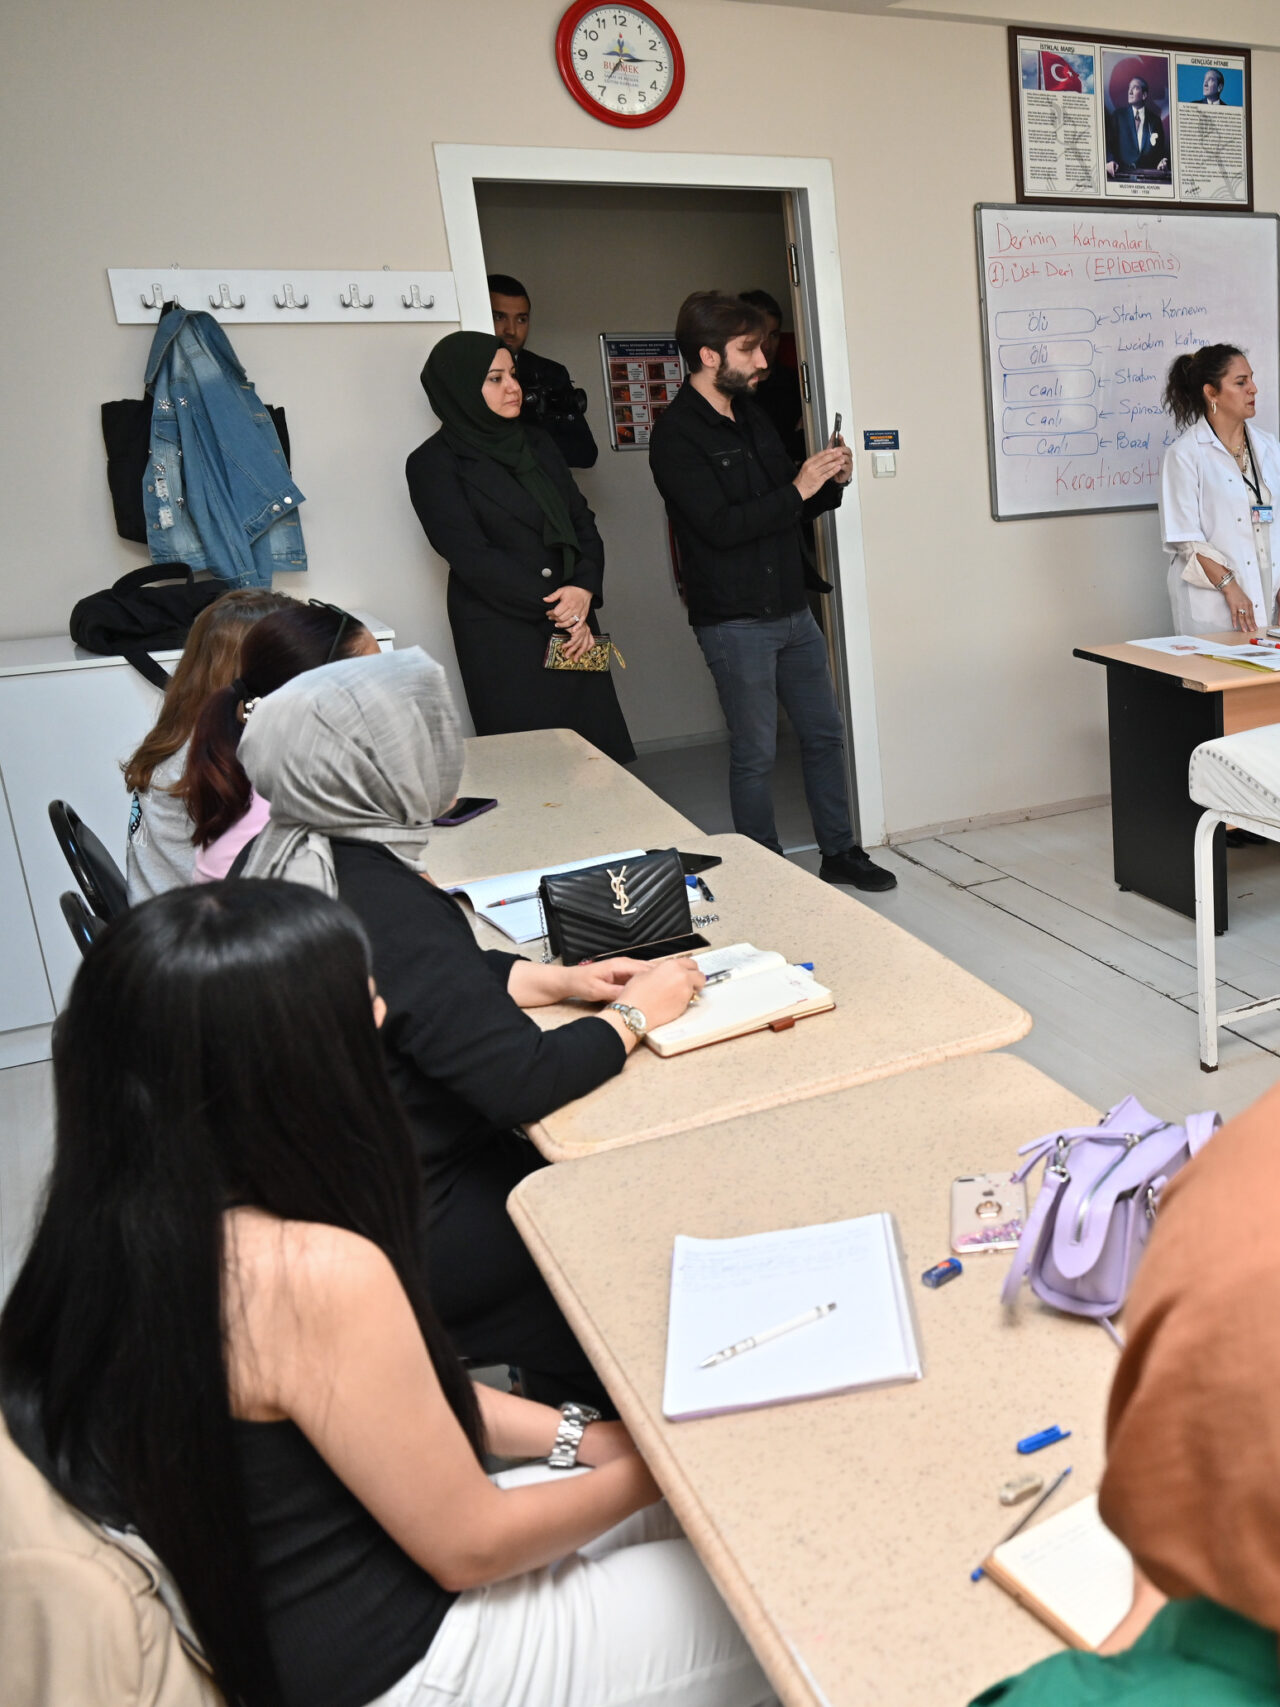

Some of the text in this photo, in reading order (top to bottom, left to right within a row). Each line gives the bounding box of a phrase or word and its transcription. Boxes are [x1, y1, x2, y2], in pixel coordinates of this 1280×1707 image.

[596, 18, 606, 29] 11
[613, 15, 627, 27] 12
[583, 29, 599, 41] 10
[648, 39, 658, 51] 2
[577, 49, 588, 60] 9
[603, 61, 640, 74] BUMEK
[655, 60, 664, 72] 3
[584, 70, 594, 81] 8
[597, 85, 607, 97] 7
[649, 80, 658, 91] 4
[617, 94, 627, 105] 6
[638, 91, 647, 102] 5
[996, 223, 1056, 252] Derinin
[1045, 261, 1073, 278] Deri
